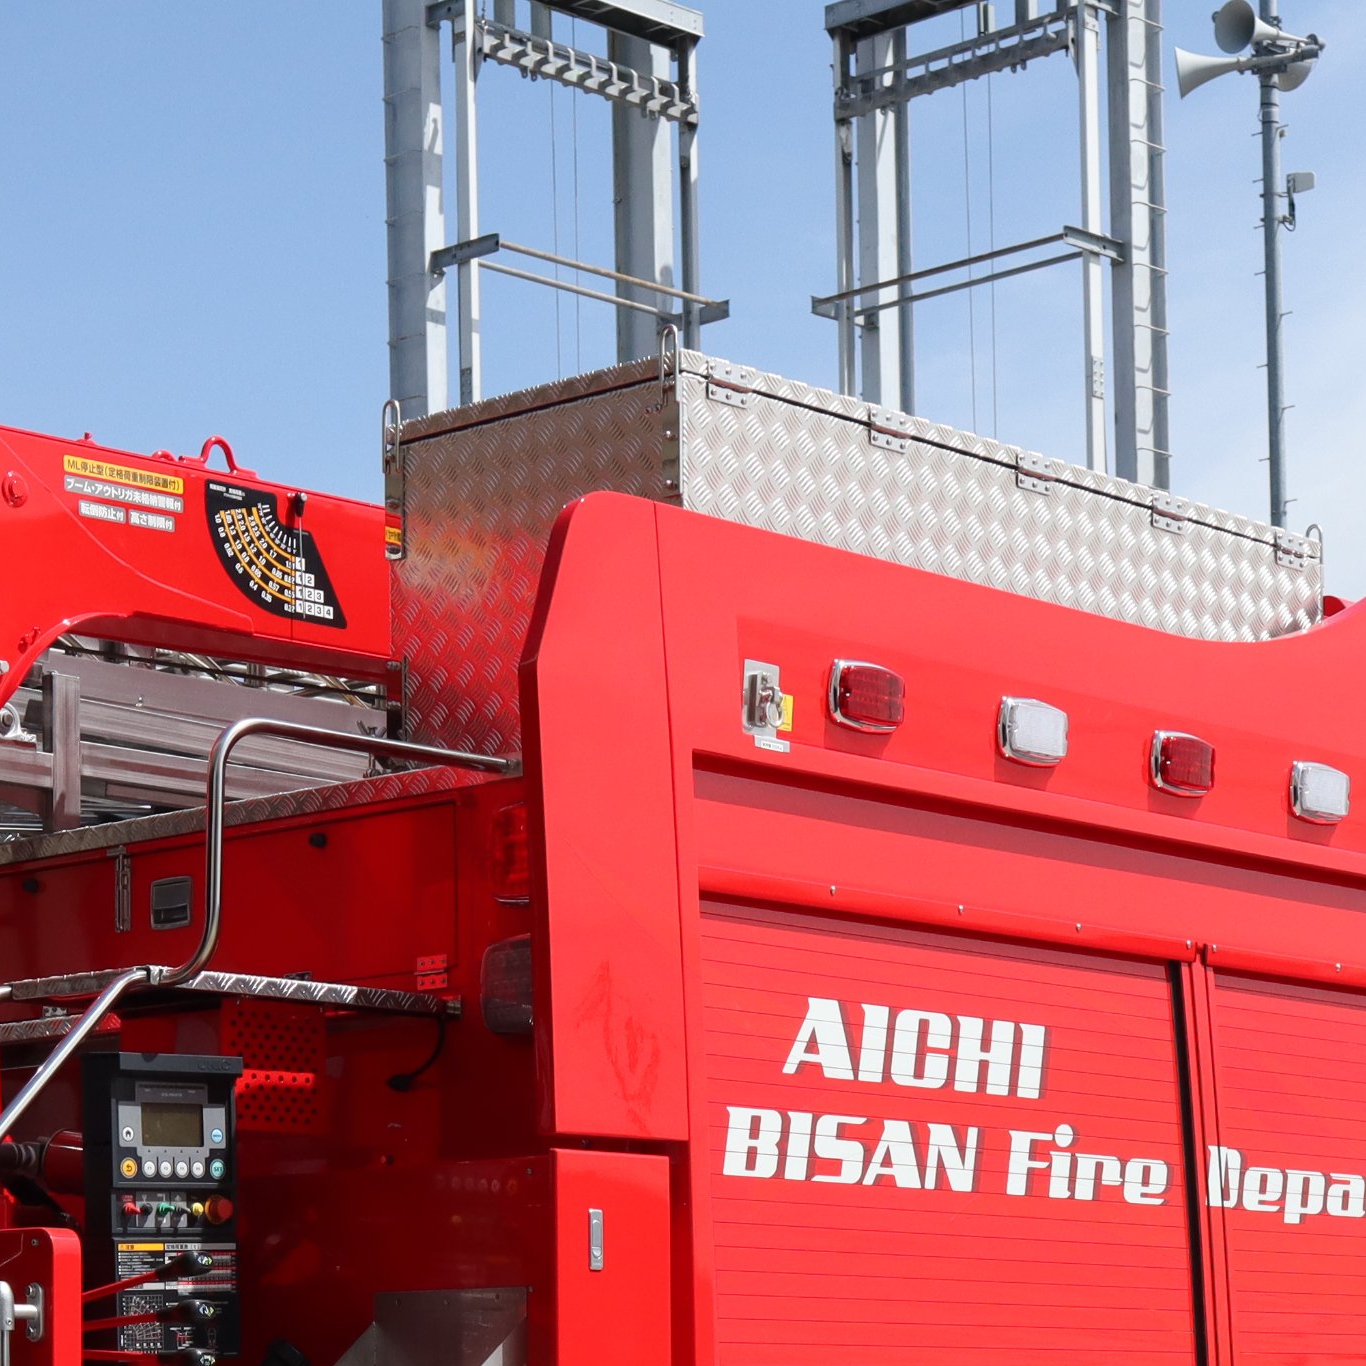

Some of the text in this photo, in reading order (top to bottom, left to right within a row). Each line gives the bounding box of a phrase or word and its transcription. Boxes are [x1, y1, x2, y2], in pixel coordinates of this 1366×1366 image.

[781, 997, 1048, 1099] AICHI
[722, 1105, 980, 1193] BISAN
[1006, 1123, 1169, 1206] Fire
